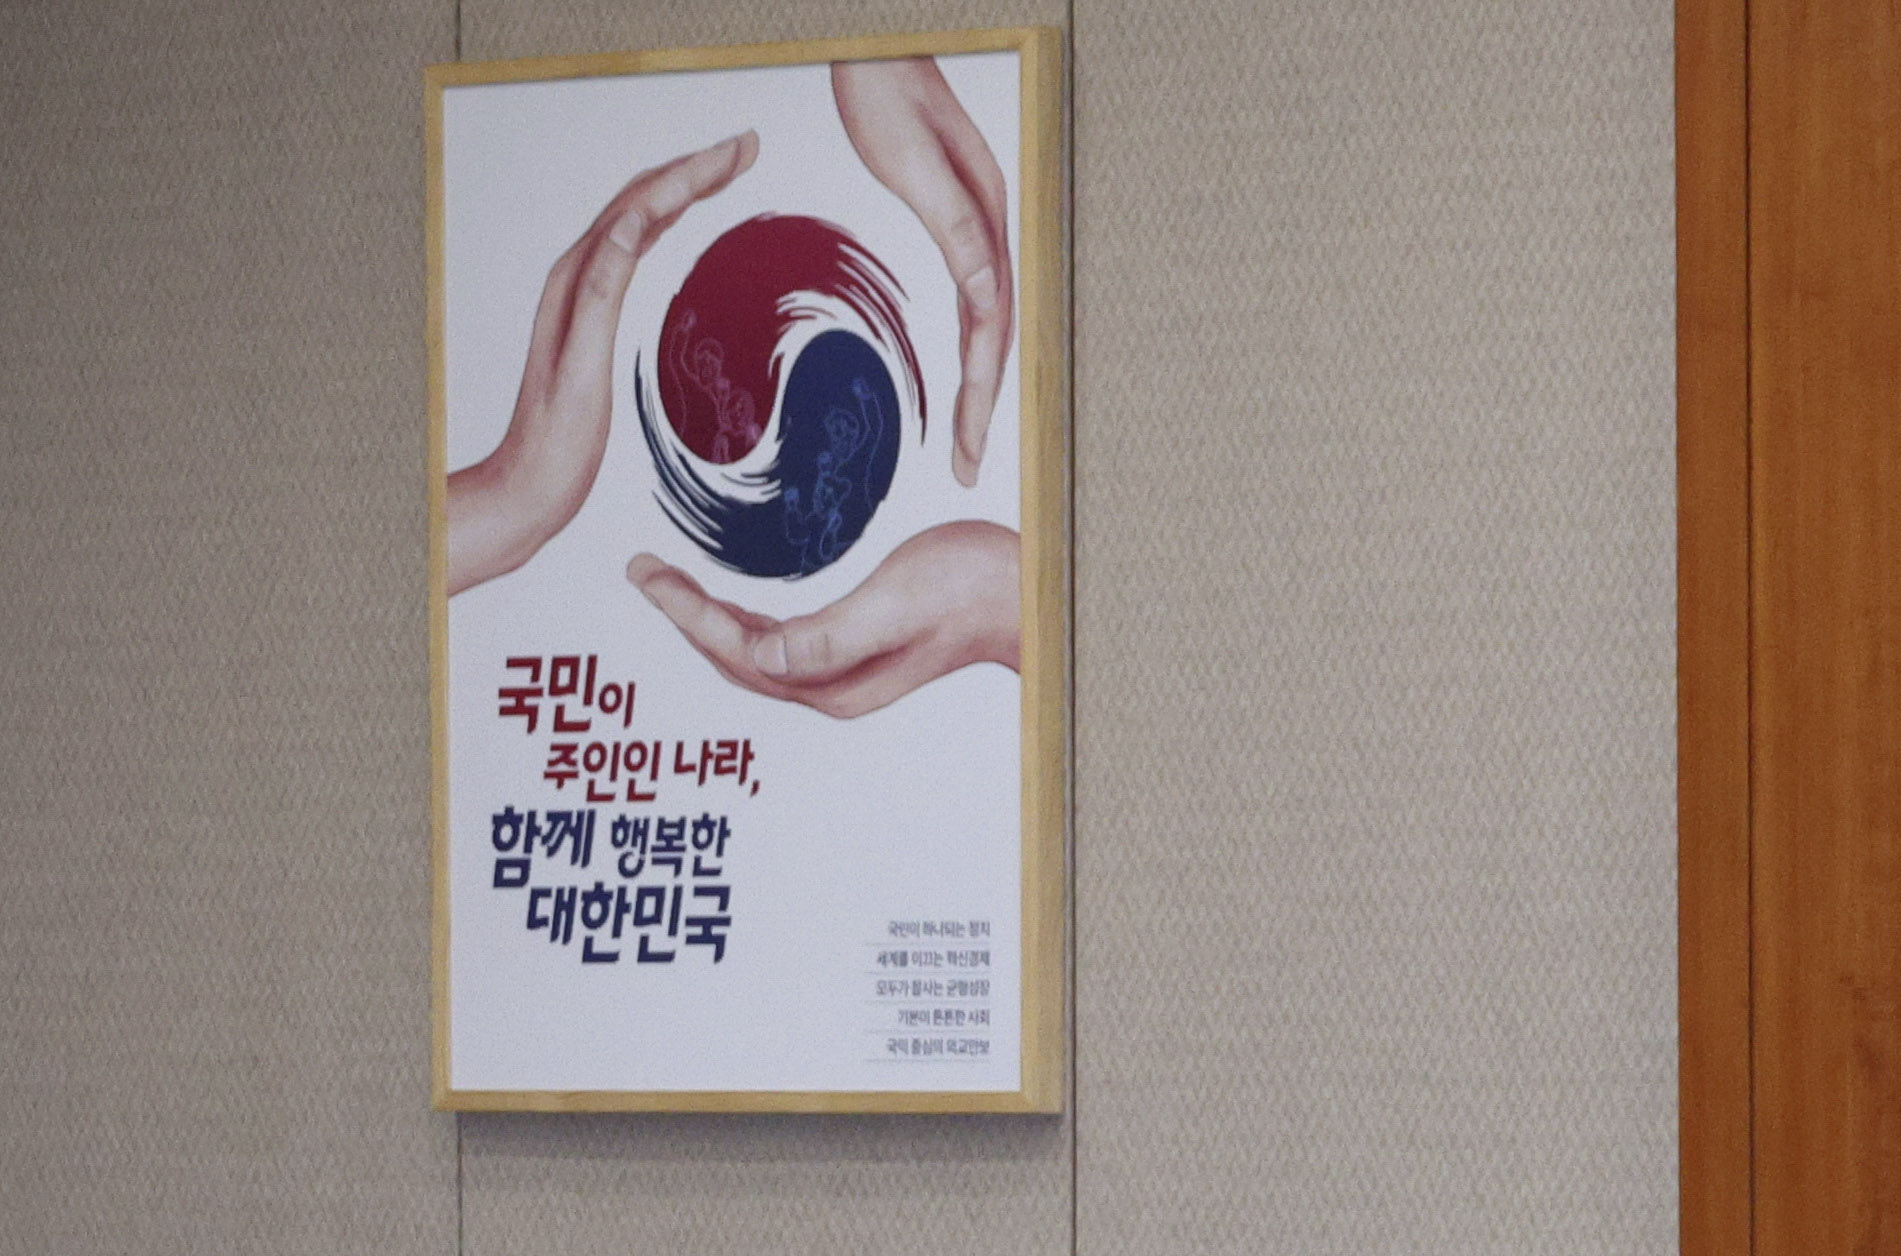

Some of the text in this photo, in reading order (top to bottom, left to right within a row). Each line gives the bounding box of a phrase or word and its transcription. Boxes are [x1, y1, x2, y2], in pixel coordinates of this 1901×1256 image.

[498, 654, 636, 735] 국민이
[543, 739, 761, 803] 주인인 나라,
[491, 806, 732, 889] 함께 행복한
[525, 881, 733, 965] 대한민국
